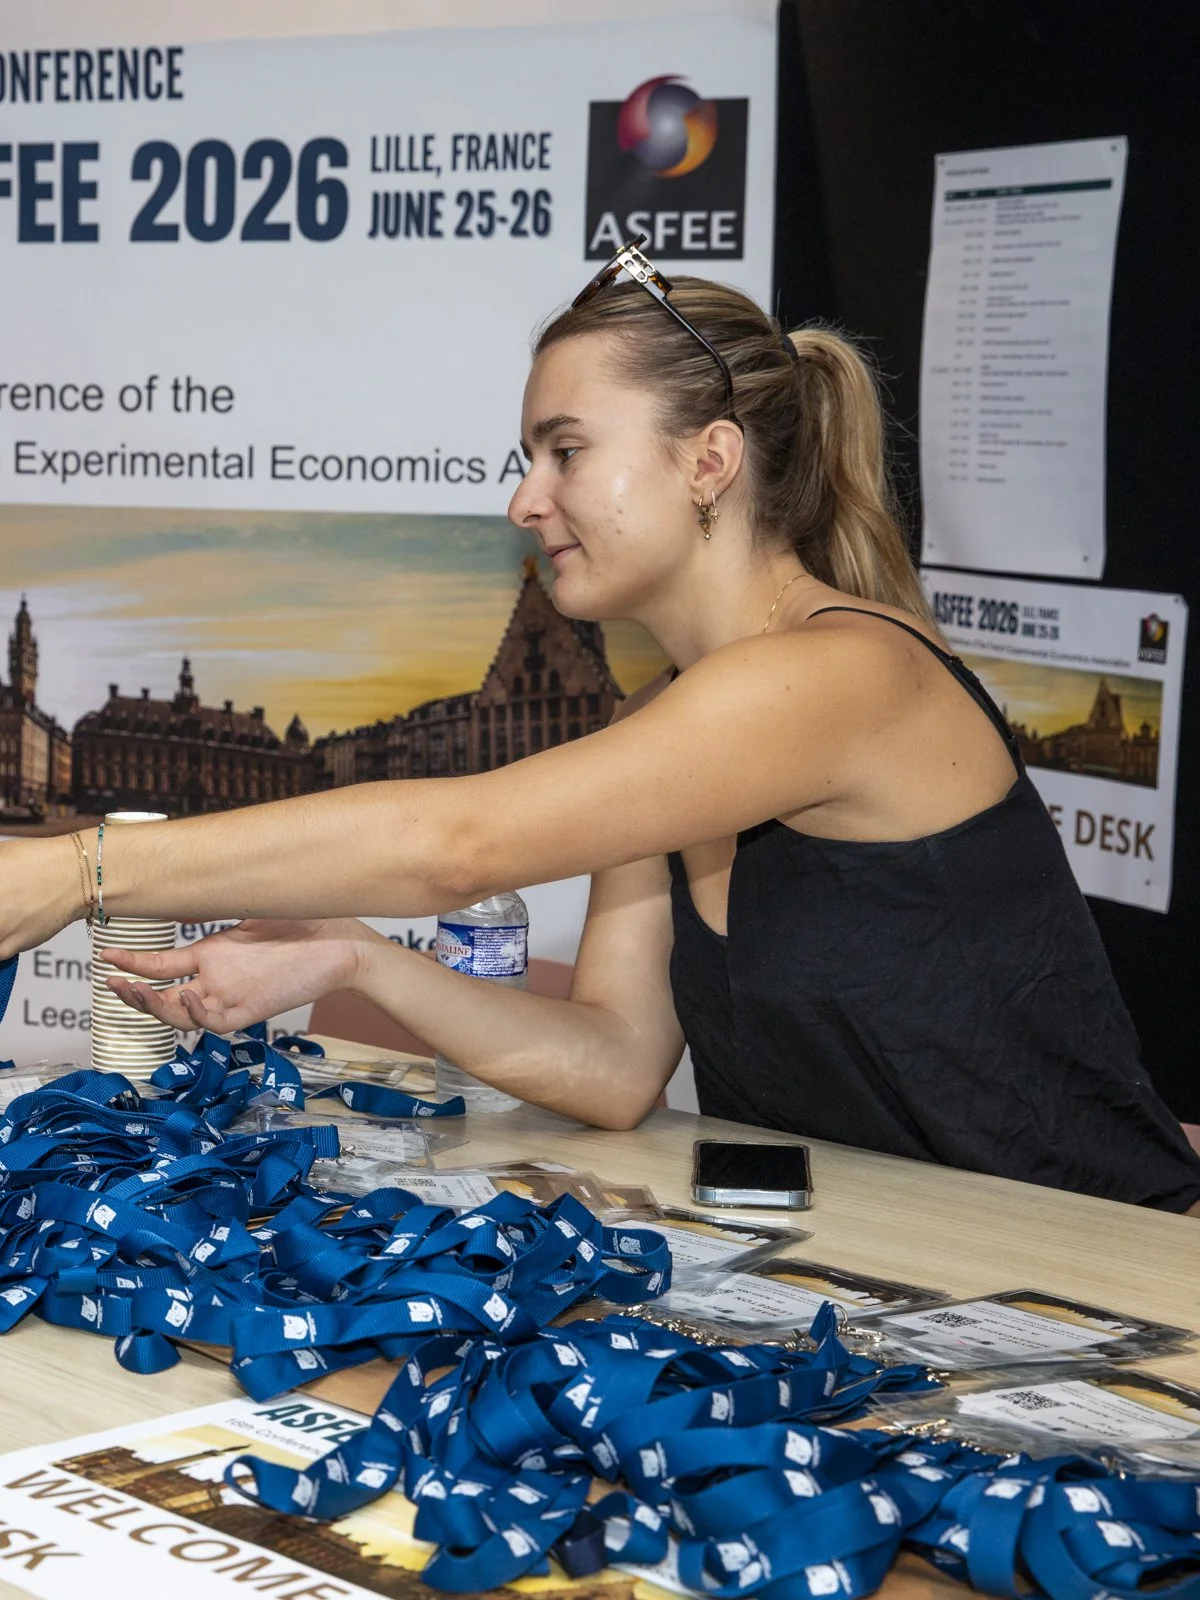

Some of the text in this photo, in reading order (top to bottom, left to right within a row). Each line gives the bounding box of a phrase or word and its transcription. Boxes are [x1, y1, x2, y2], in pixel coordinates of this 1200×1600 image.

[370, 132, 552, 176] LILLE, FRANCE
[129, 137, 350, 244] 2026
[368, 188, 552, 239] JUNE 25-26
[589, 209, 738, 251] ASFEE
[118, 374, 160, 413] of
[172, 376, 235, 413] the
[13, 441, 255, 484] Experimental
[270, 446, 487, 484] Economics
[978, 598, 1019, 635] 2026
[1074, 808, 1156, 862] DESK
[23, 998, 93, 1031] Leea
[3, 1469, 350, 1600] WELCOME
